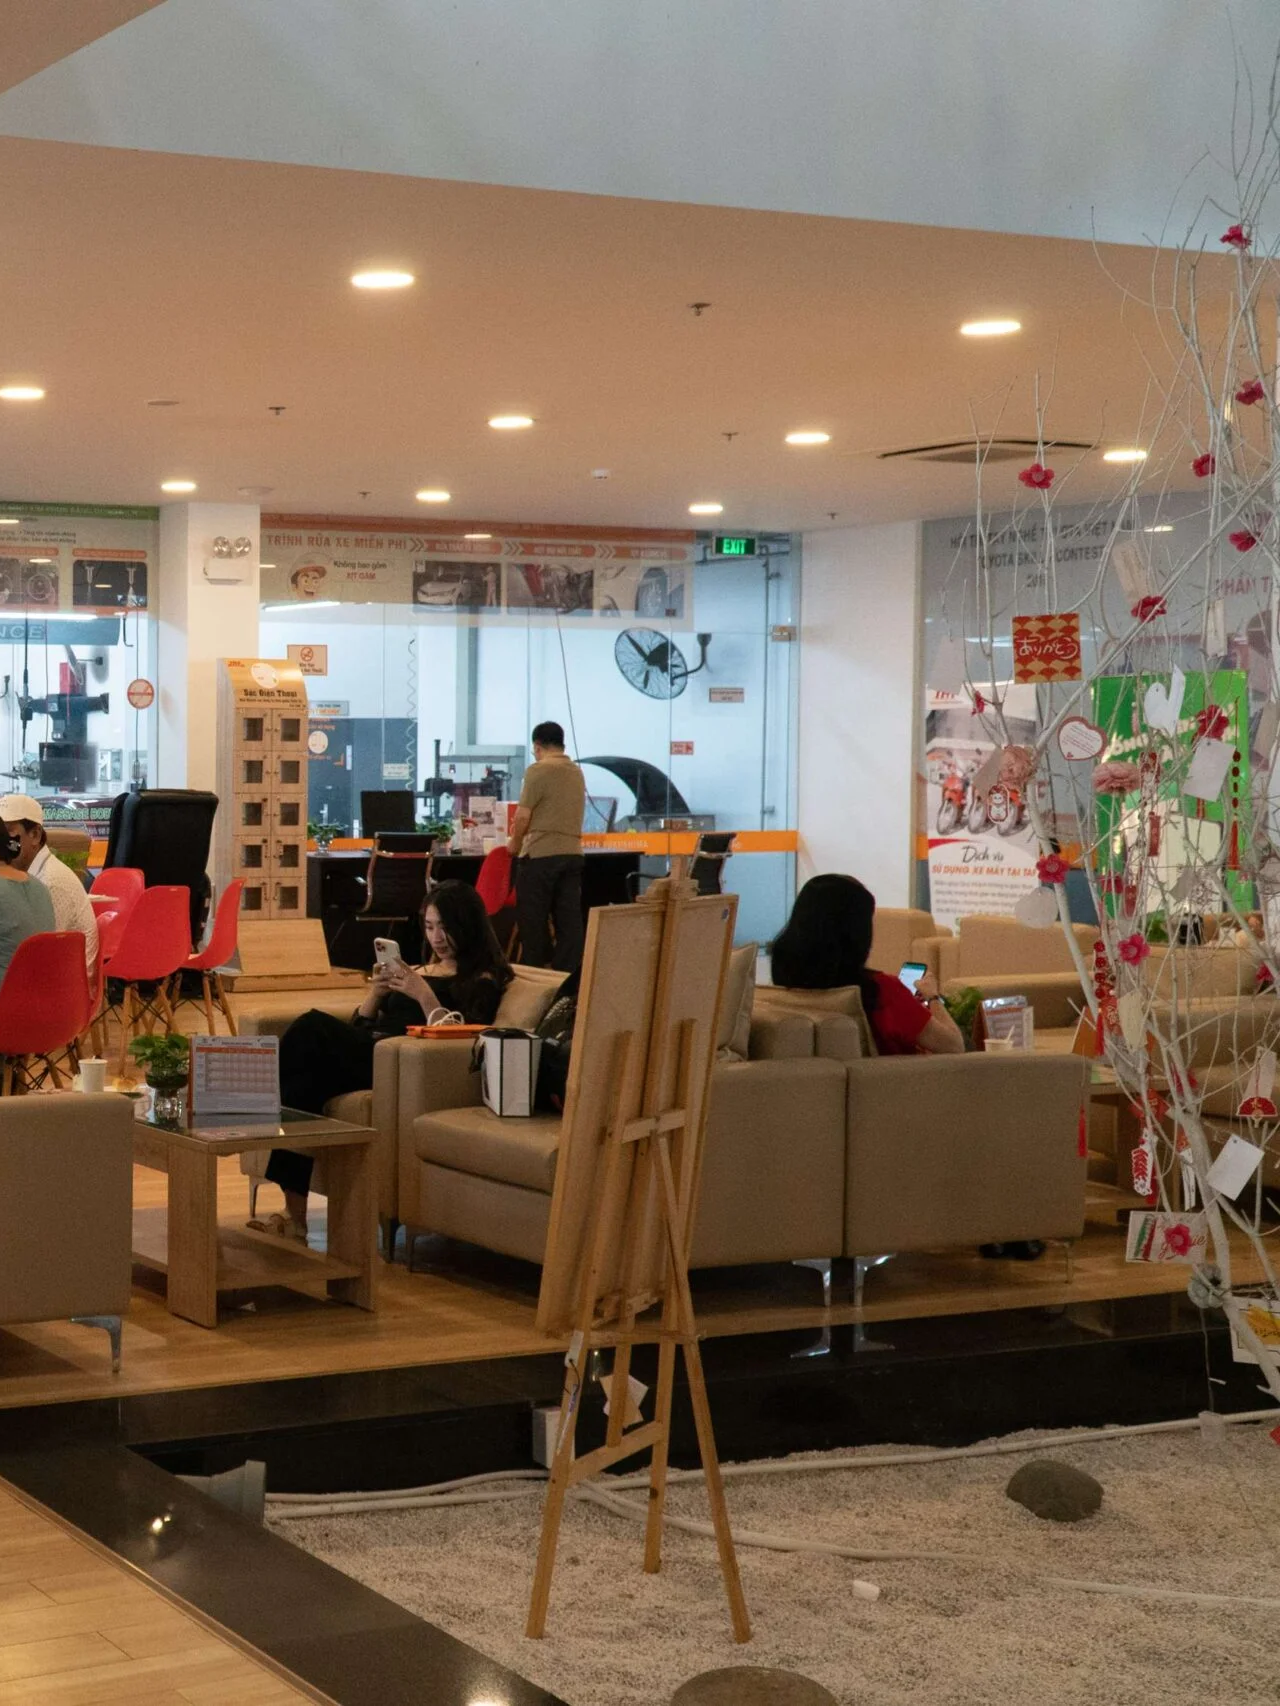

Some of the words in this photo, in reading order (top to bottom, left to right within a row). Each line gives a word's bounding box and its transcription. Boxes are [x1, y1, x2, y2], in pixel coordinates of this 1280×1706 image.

[336, 536, 351, 548] XE
[722, 538, 746, 555] EXIT
[43, 807, 89, 820] MASSAGE
[972, 866, 983, 875] XE
